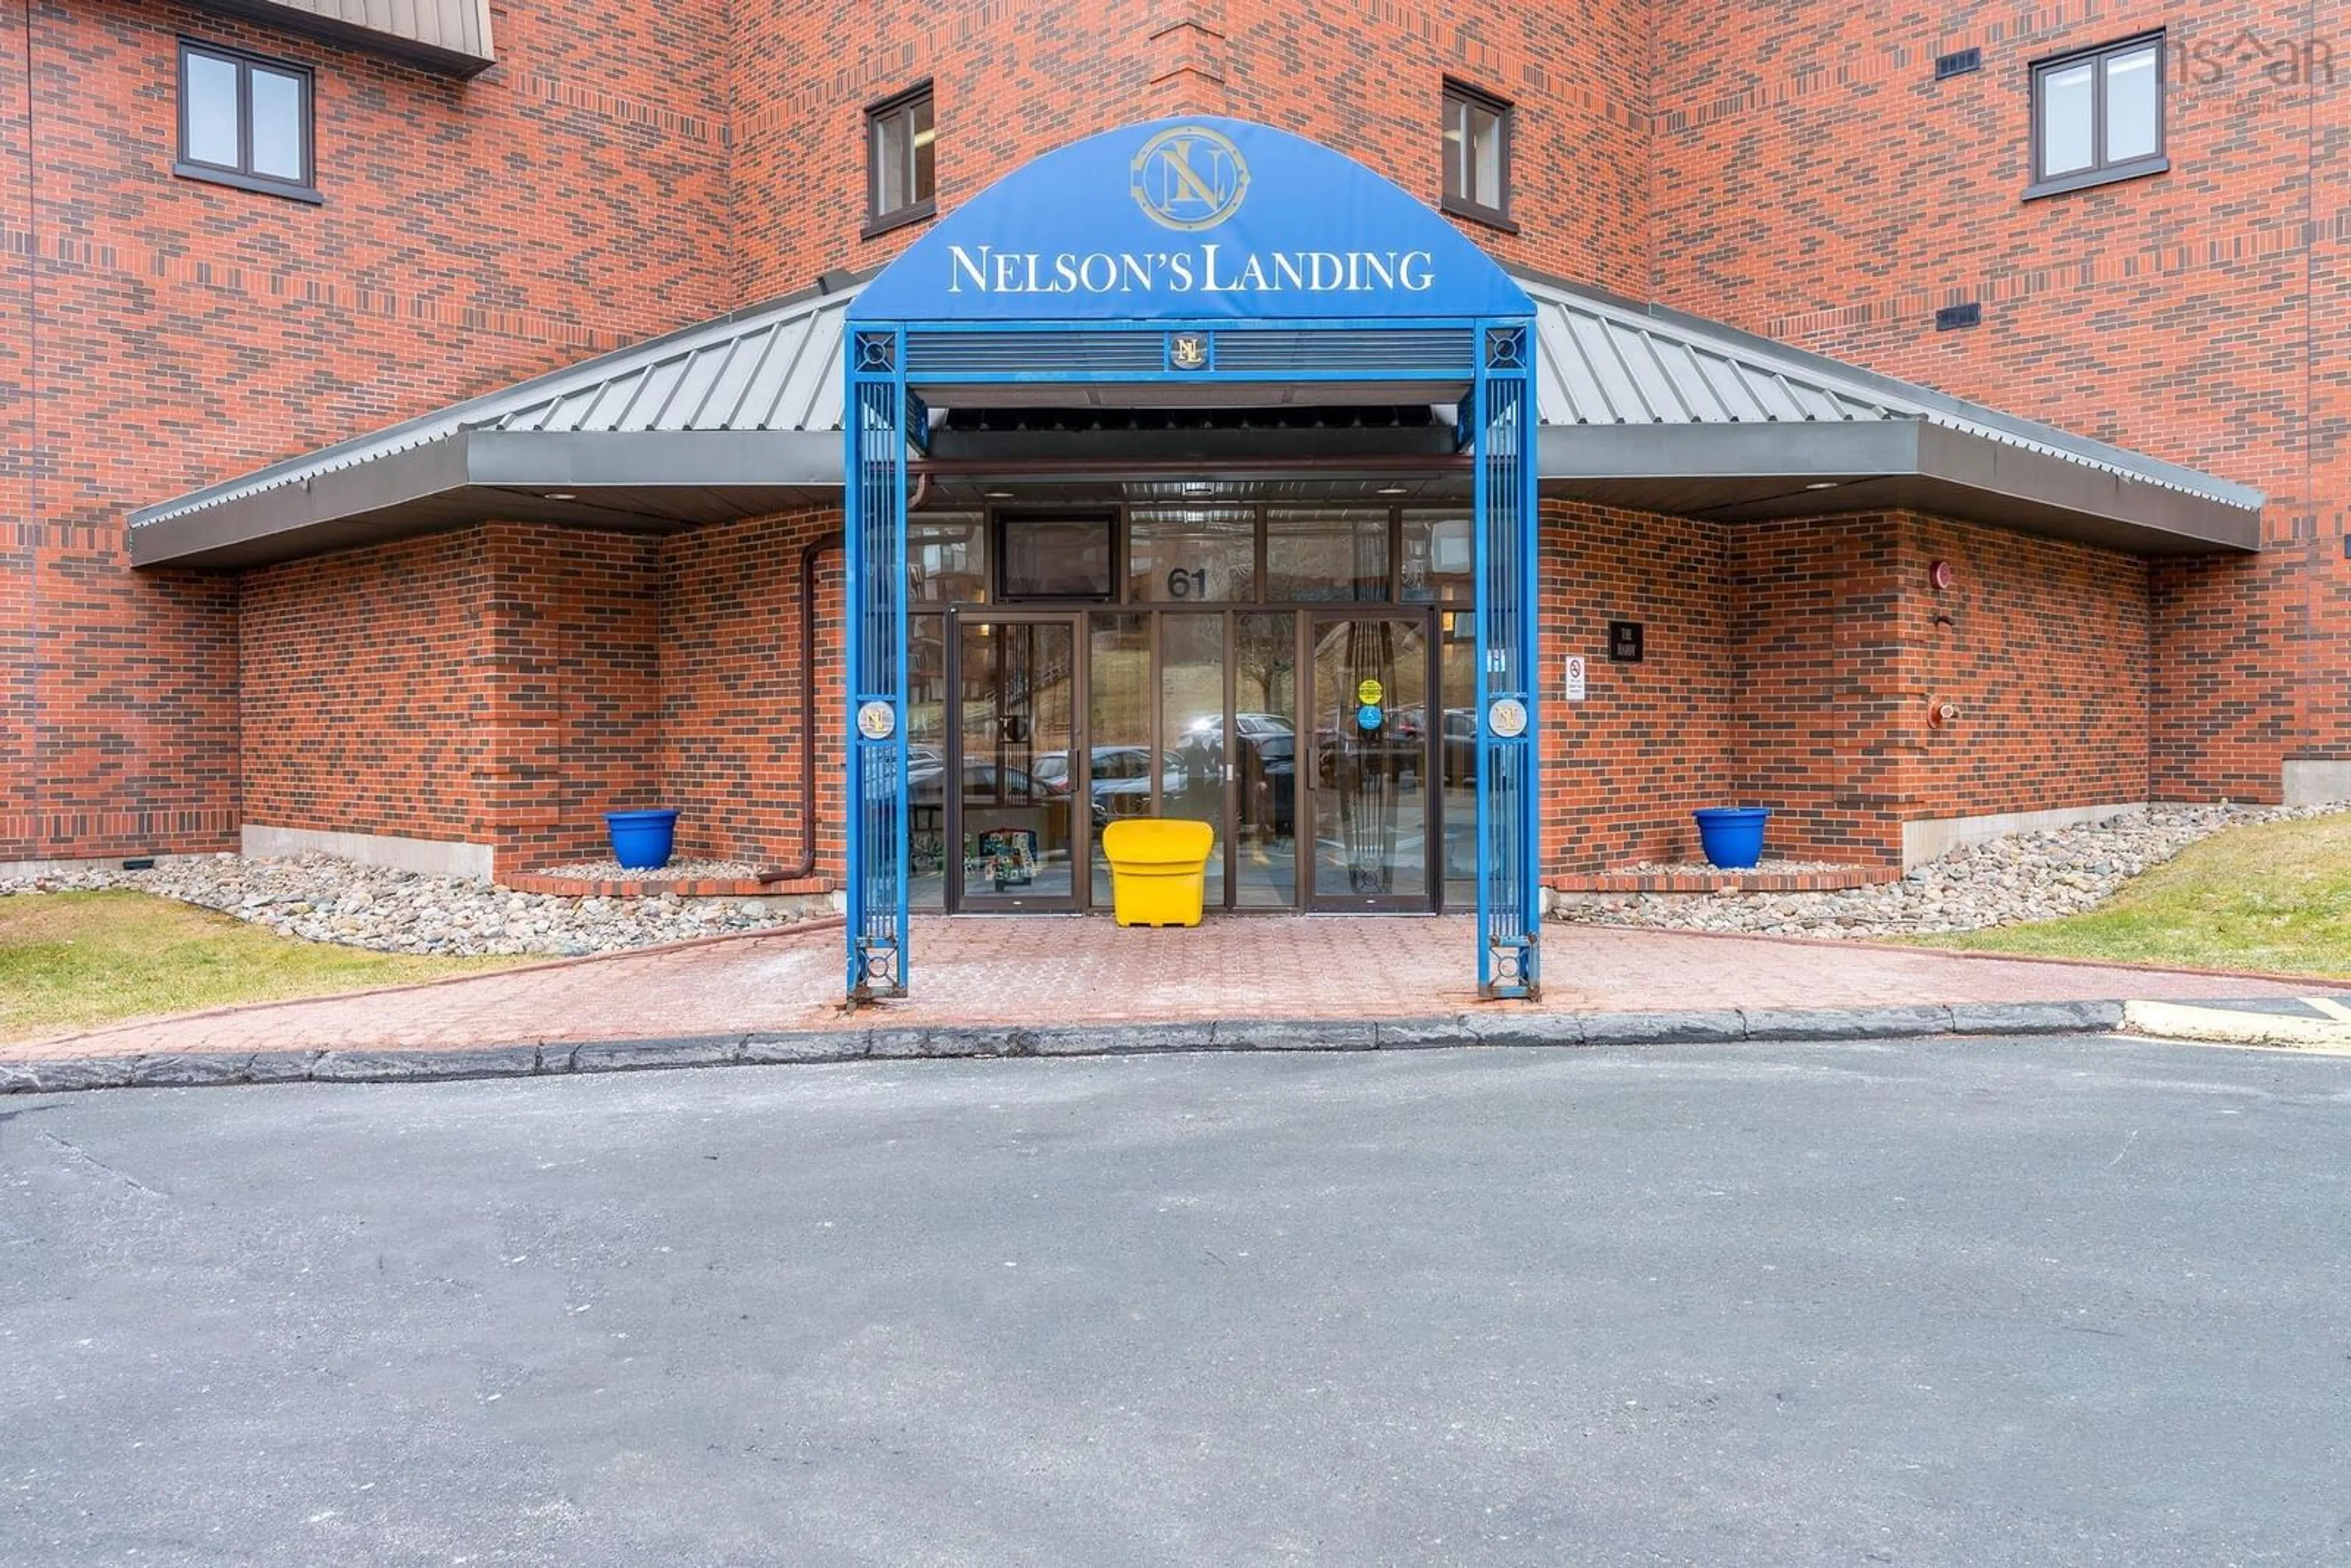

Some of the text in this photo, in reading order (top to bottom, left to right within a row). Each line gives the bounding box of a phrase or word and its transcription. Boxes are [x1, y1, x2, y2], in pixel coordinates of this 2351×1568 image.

[947, 244, 1435, 293] NELSON'S LANDING
[1168, 567, 1205, 598] 61
